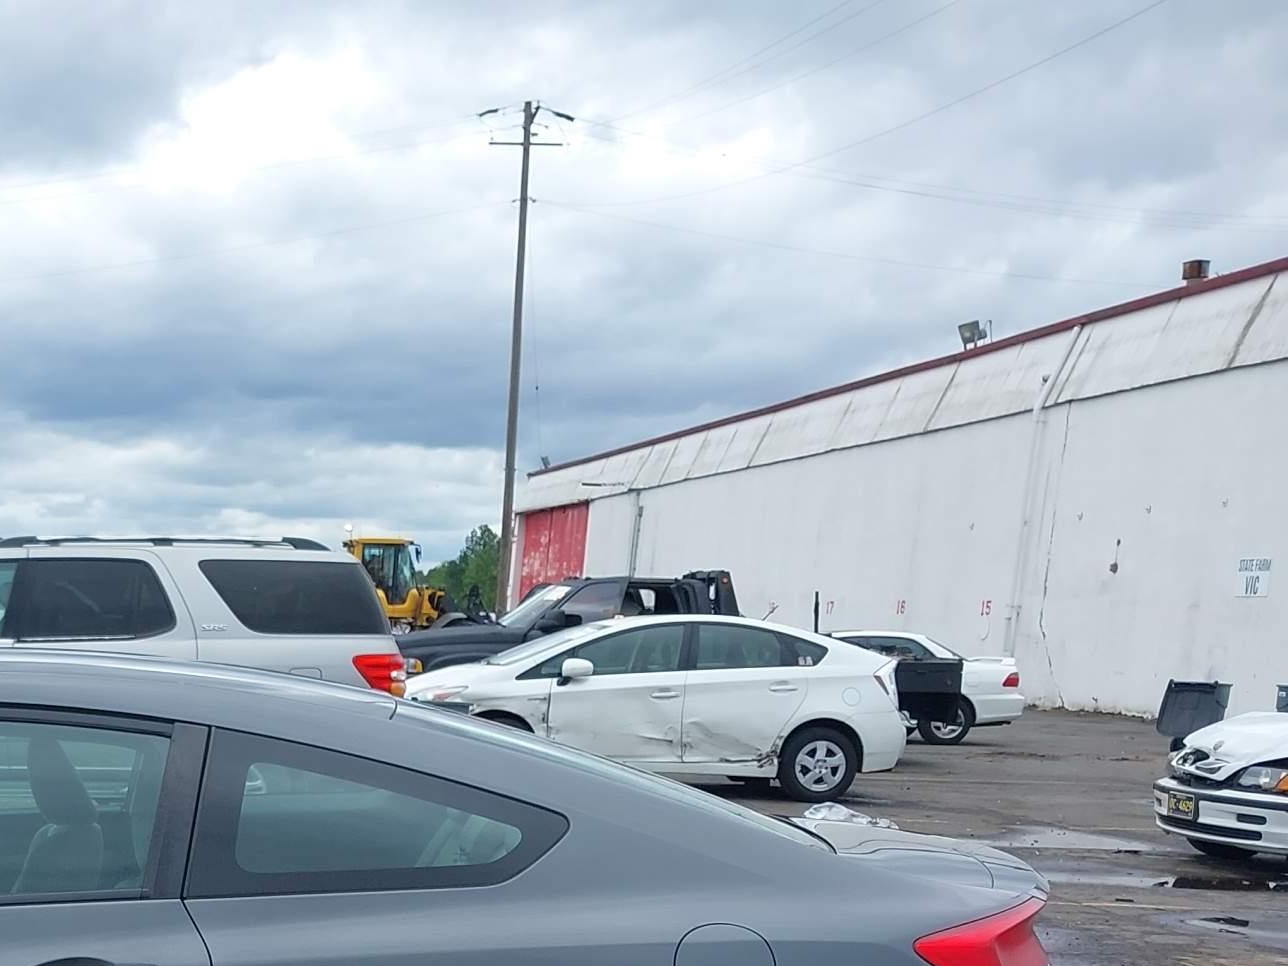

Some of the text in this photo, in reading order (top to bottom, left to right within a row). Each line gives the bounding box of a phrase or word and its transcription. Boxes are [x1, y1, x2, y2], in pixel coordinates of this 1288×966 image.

[1239, 559, 1272, 572] STATE FARM
[1245, 575, 1259, 595] VIC
[826, 601, 835, 615] 17
[896, 600, 906, 615] 16
[980, 600, 992, 616] 15
